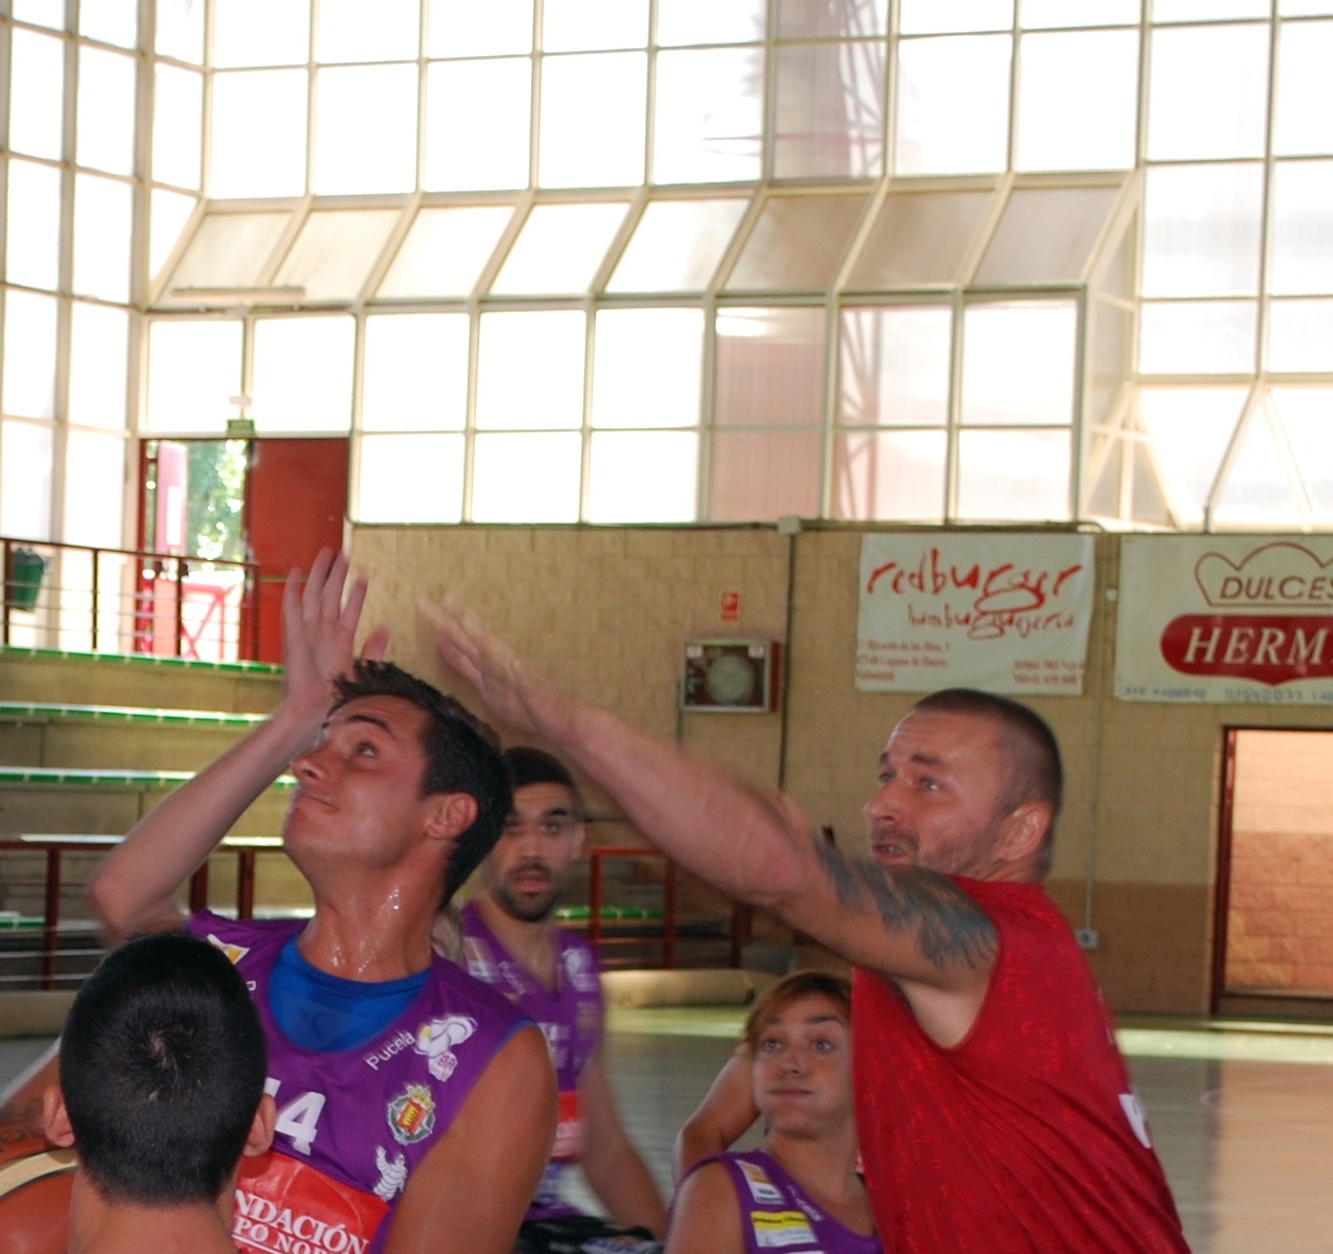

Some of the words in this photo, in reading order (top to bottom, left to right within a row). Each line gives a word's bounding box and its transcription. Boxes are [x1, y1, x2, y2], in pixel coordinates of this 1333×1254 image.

[1183, 626, 1333, 667] HERM
[365, 1029, 416, 1070] Pucela
[263, 1076, 327, 1156] 4
[232, 1216, 270, 1242] PO
